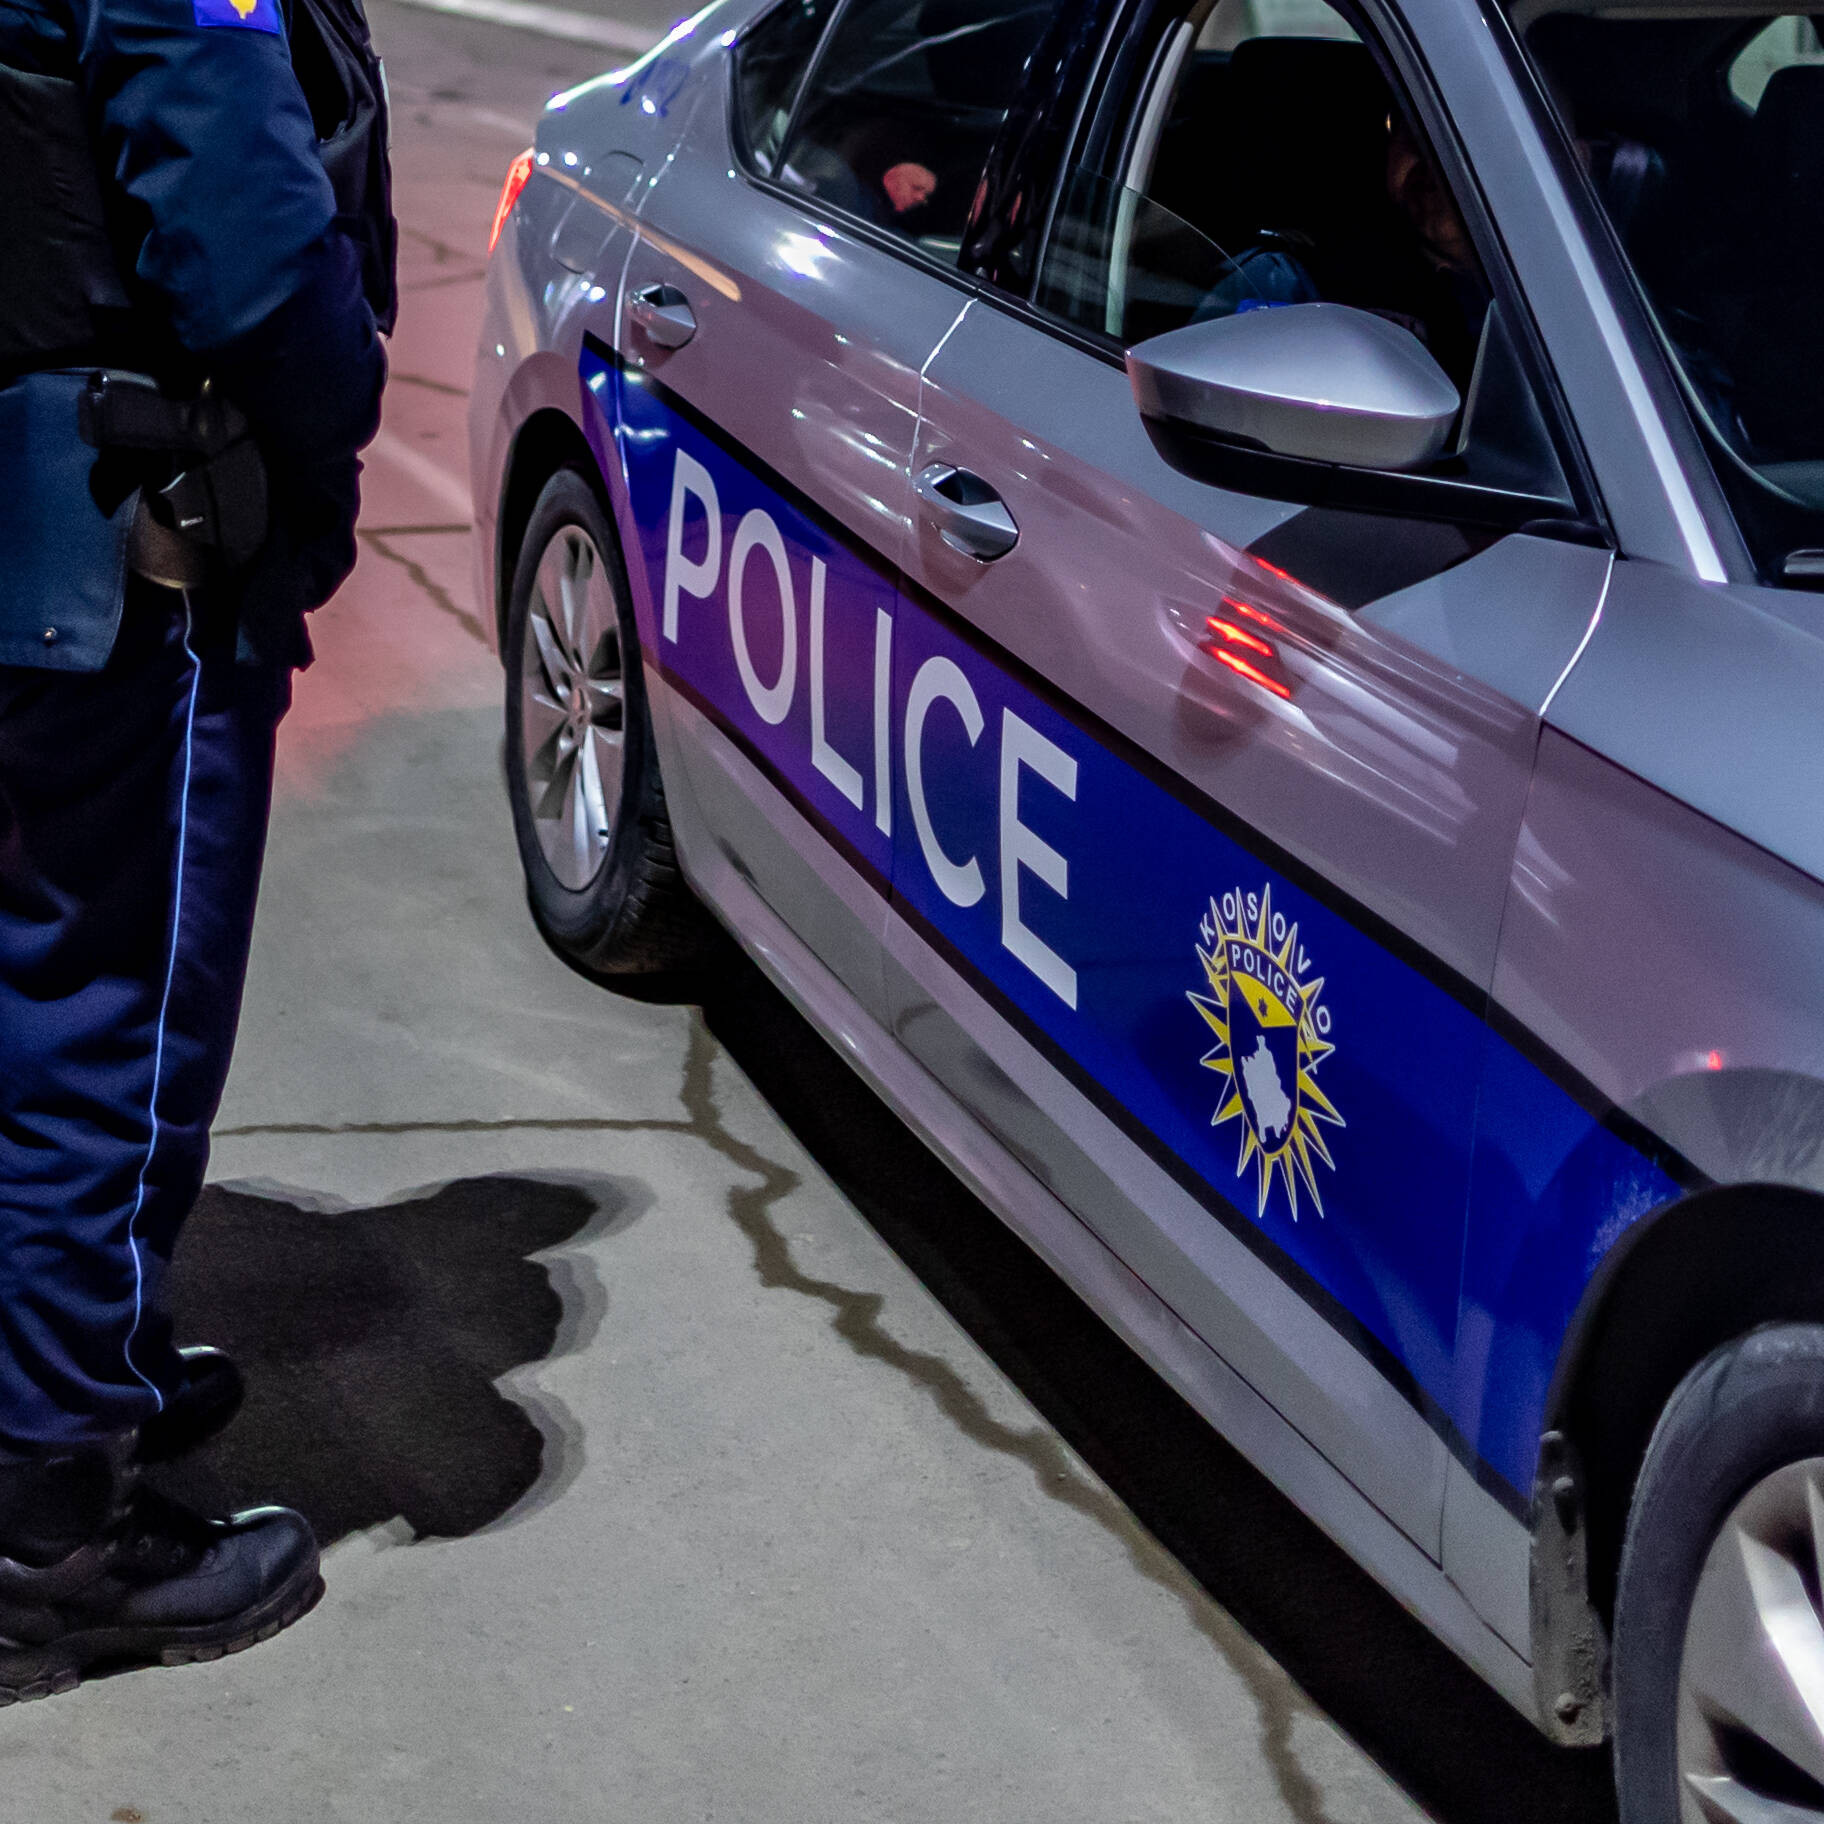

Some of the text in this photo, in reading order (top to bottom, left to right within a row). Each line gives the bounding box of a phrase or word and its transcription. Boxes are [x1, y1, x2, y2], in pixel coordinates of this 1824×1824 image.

[662, 448, 1078, 1012] POLICE
[1199, 892, 1332, 1035] KOSOVO
[1231, 943, 1298, 1014] POLICE
